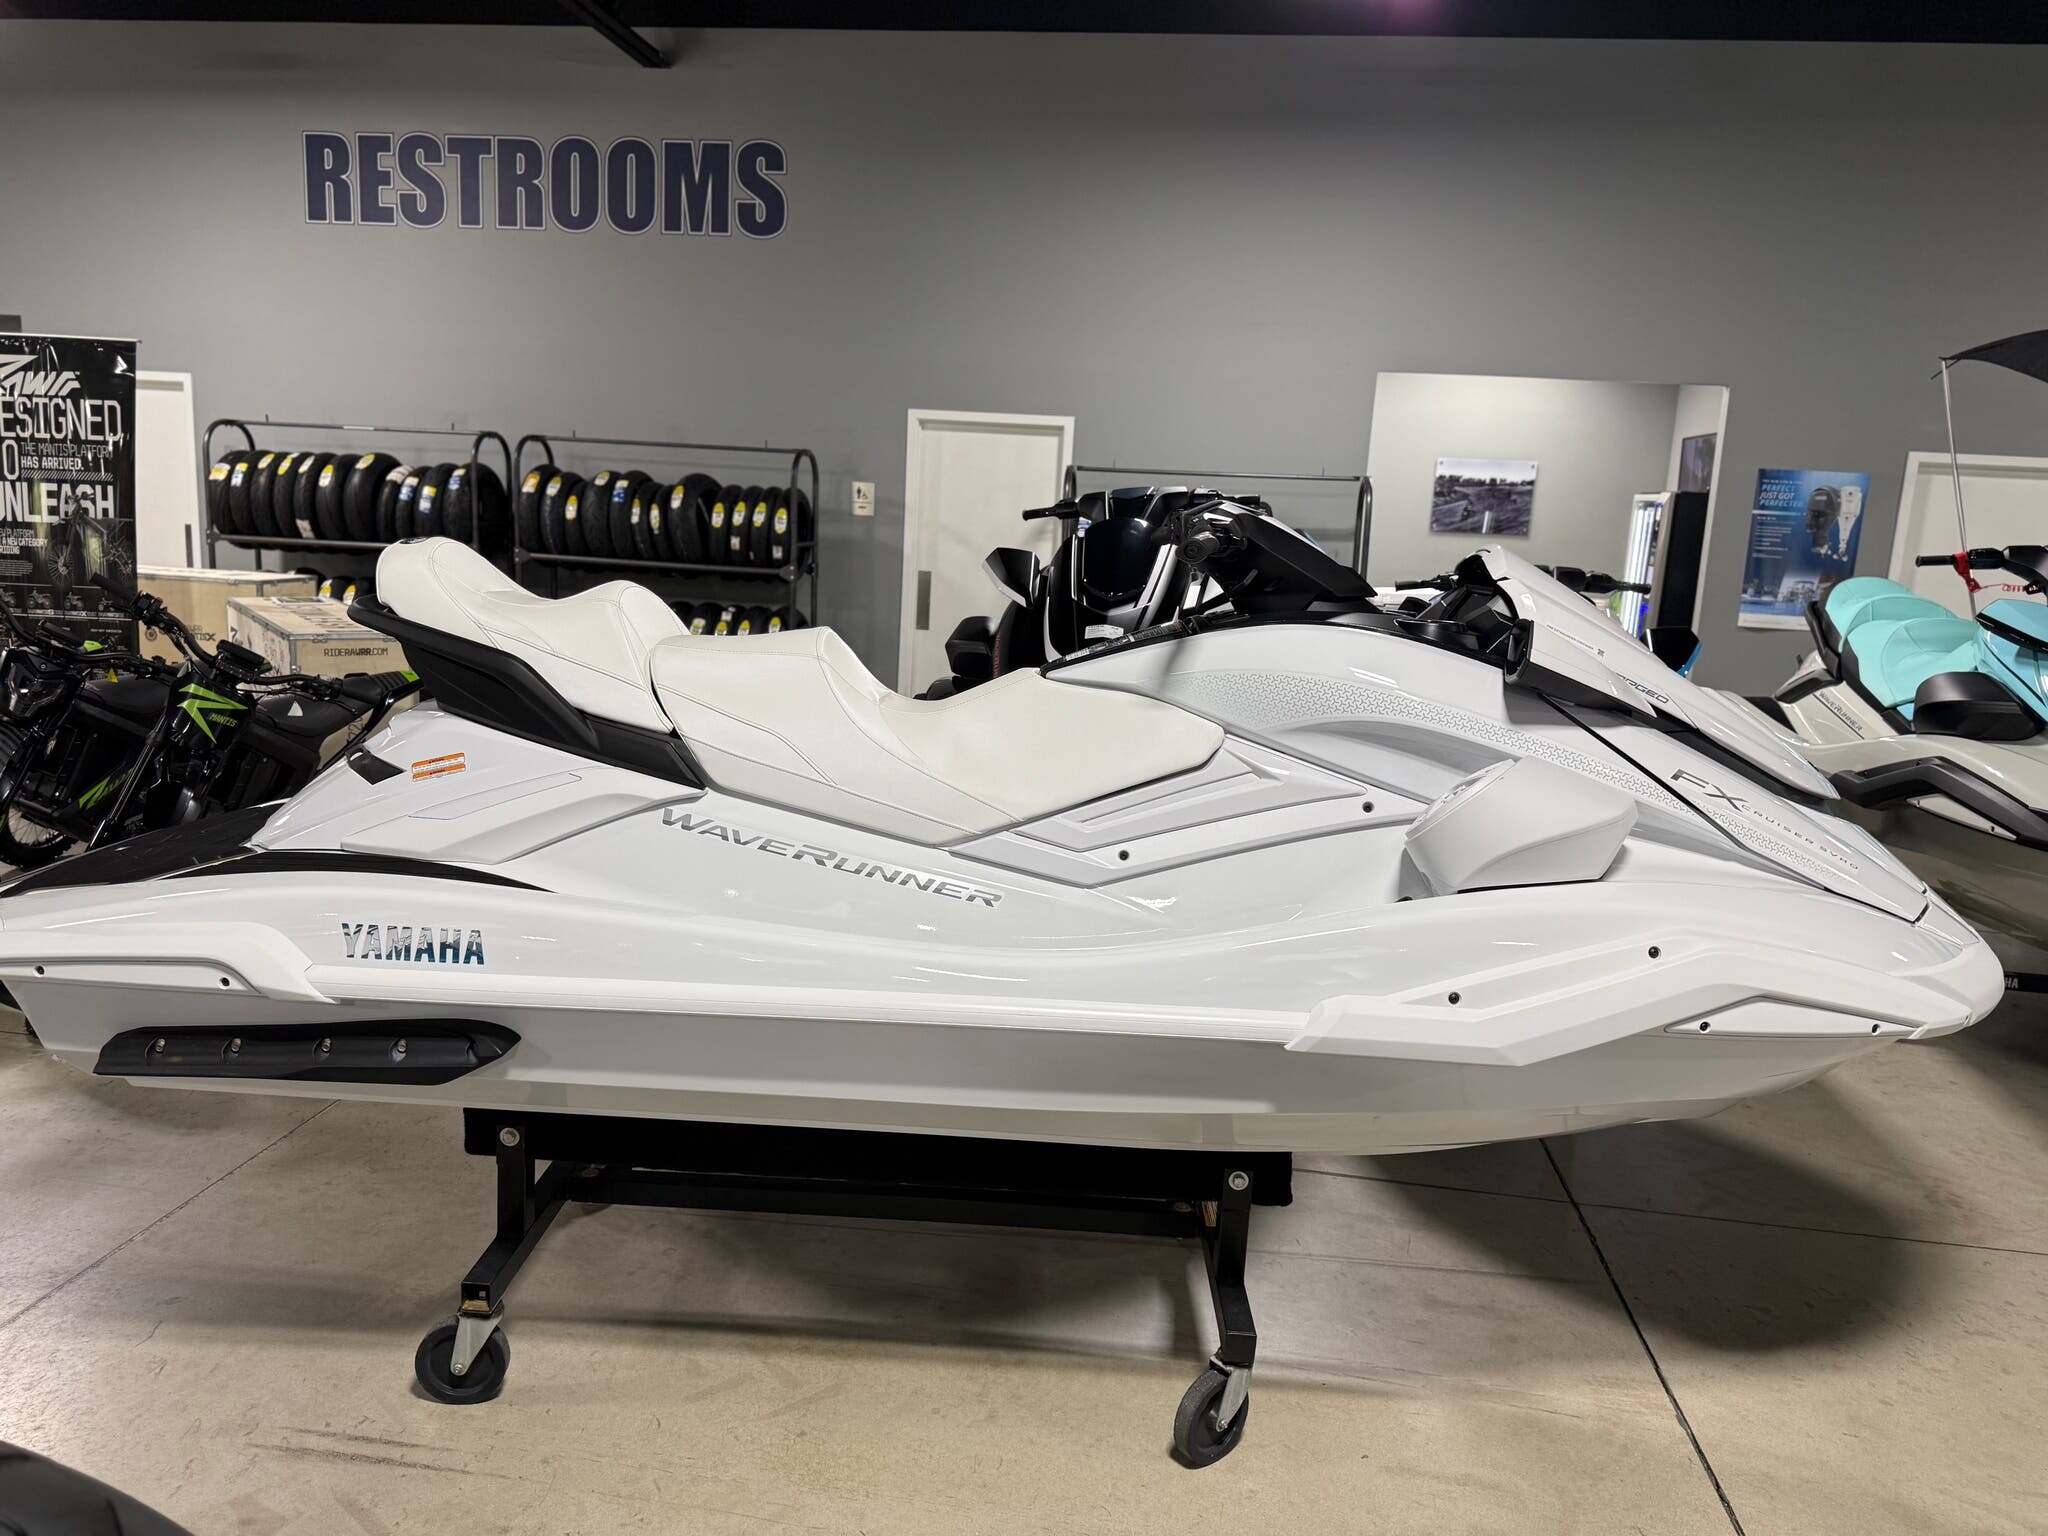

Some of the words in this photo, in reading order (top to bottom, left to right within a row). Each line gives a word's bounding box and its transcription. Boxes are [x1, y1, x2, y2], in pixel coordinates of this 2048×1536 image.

[302, 130, 788, 240] RESTROOMS
[0, 396, 122, 441] ESIGNED
[1, 439, 20, 481] O
[21, 442, 37, 455] THE
[21, 456, 39, 468] HAS
[41, 456, 85, 470] ARRIVED.
[1778, 492, 1795, 500] GOT
[1670, 768, 1749, 813] FX
[662, 807, 1002, 908] WAVERUNNER
[341, 922, 485, 965] YAMAHA
